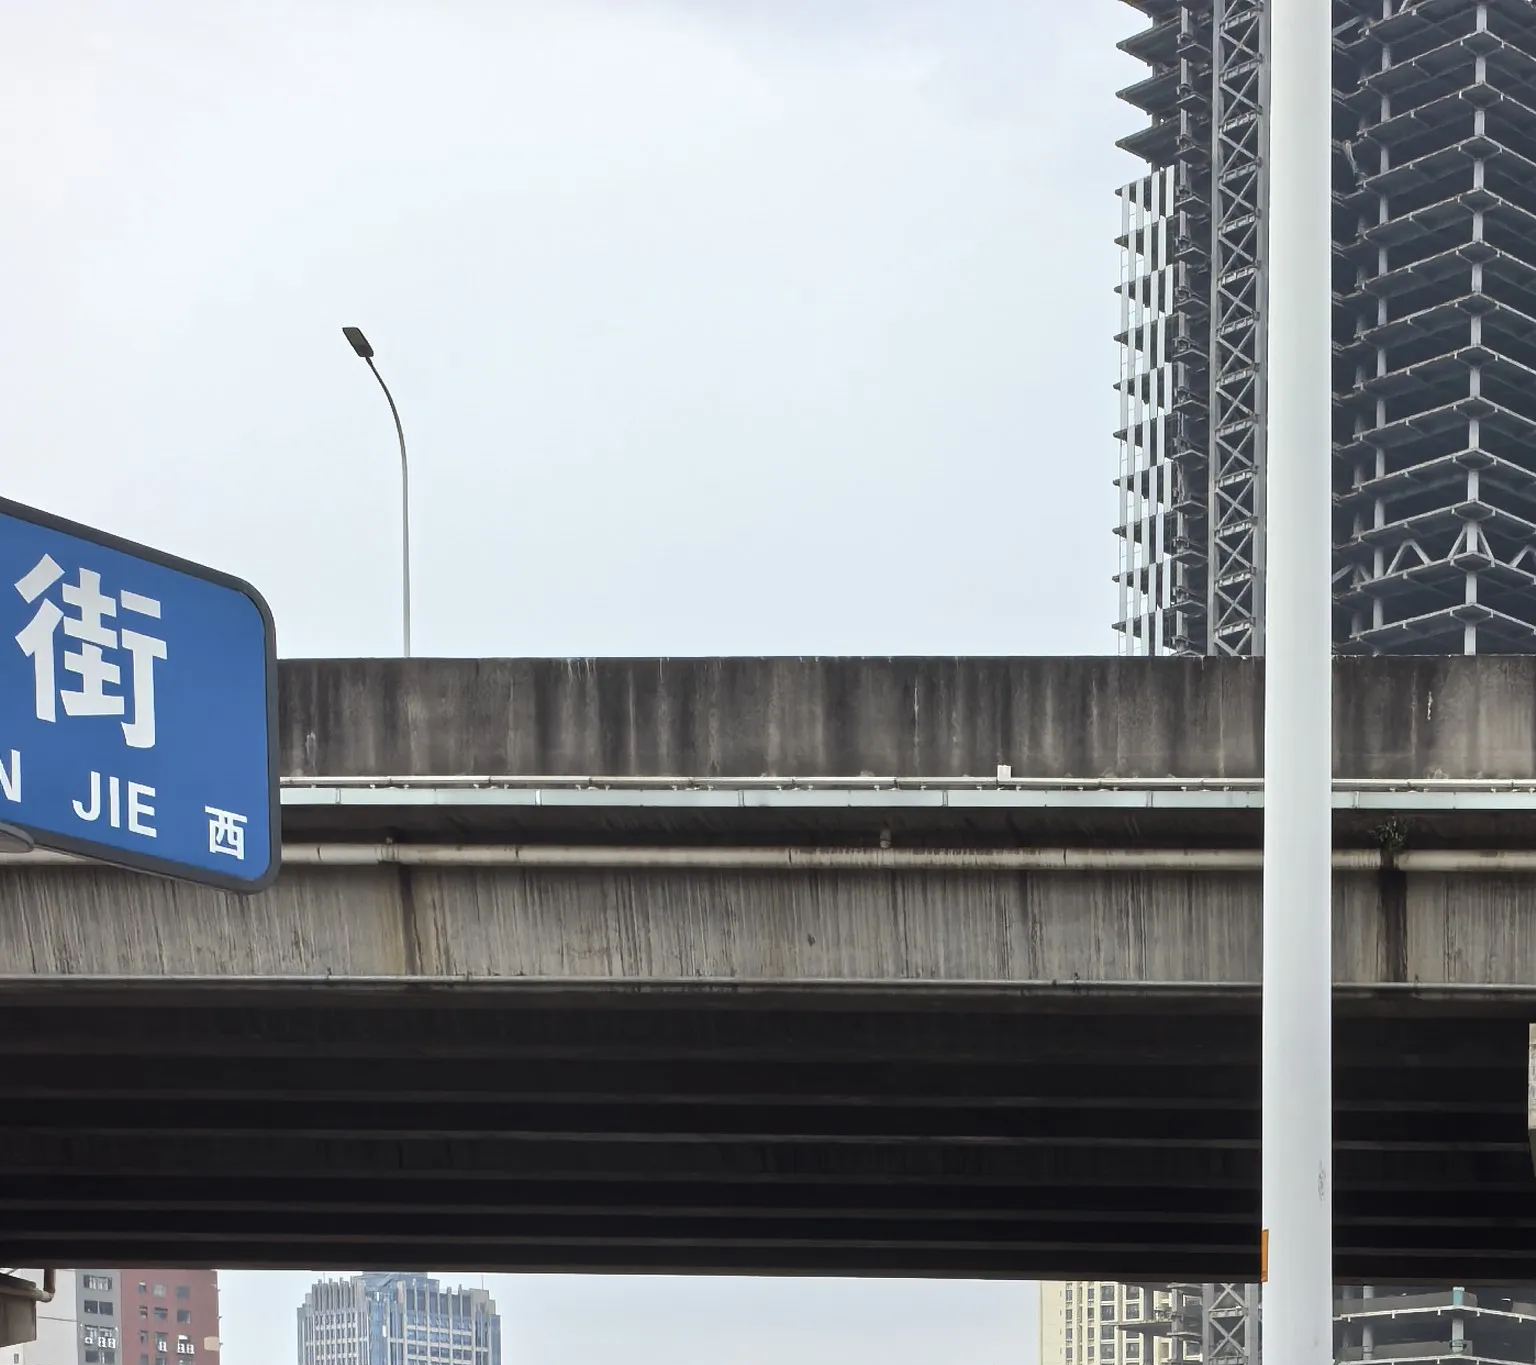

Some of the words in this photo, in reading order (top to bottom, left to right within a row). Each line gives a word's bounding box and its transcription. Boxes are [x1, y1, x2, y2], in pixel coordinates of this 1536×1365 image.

[14, 553, 168, 749] 街
[72, 771, 157, 838] JIE
[205, 805, 248, 860] 西
